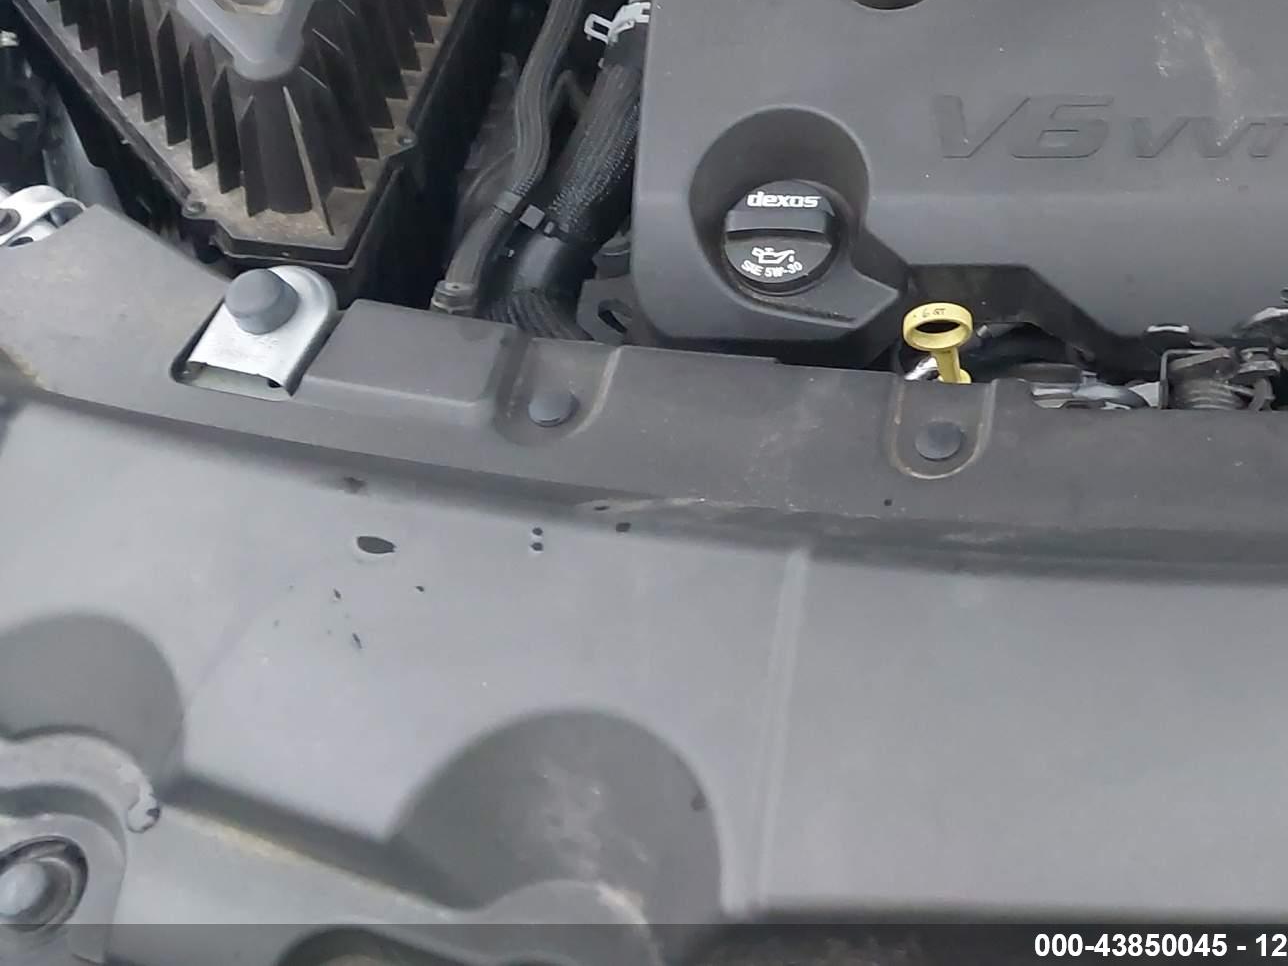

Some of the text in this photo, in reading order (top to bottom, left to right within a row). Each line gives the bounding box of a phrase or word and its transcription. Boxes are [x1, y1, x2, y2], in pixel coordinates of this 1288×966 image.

[932, 94, 1114, 159] V6
[747, 191, 822, 208] dexos
[741, 260, 803, 277] SAE 5W-30
